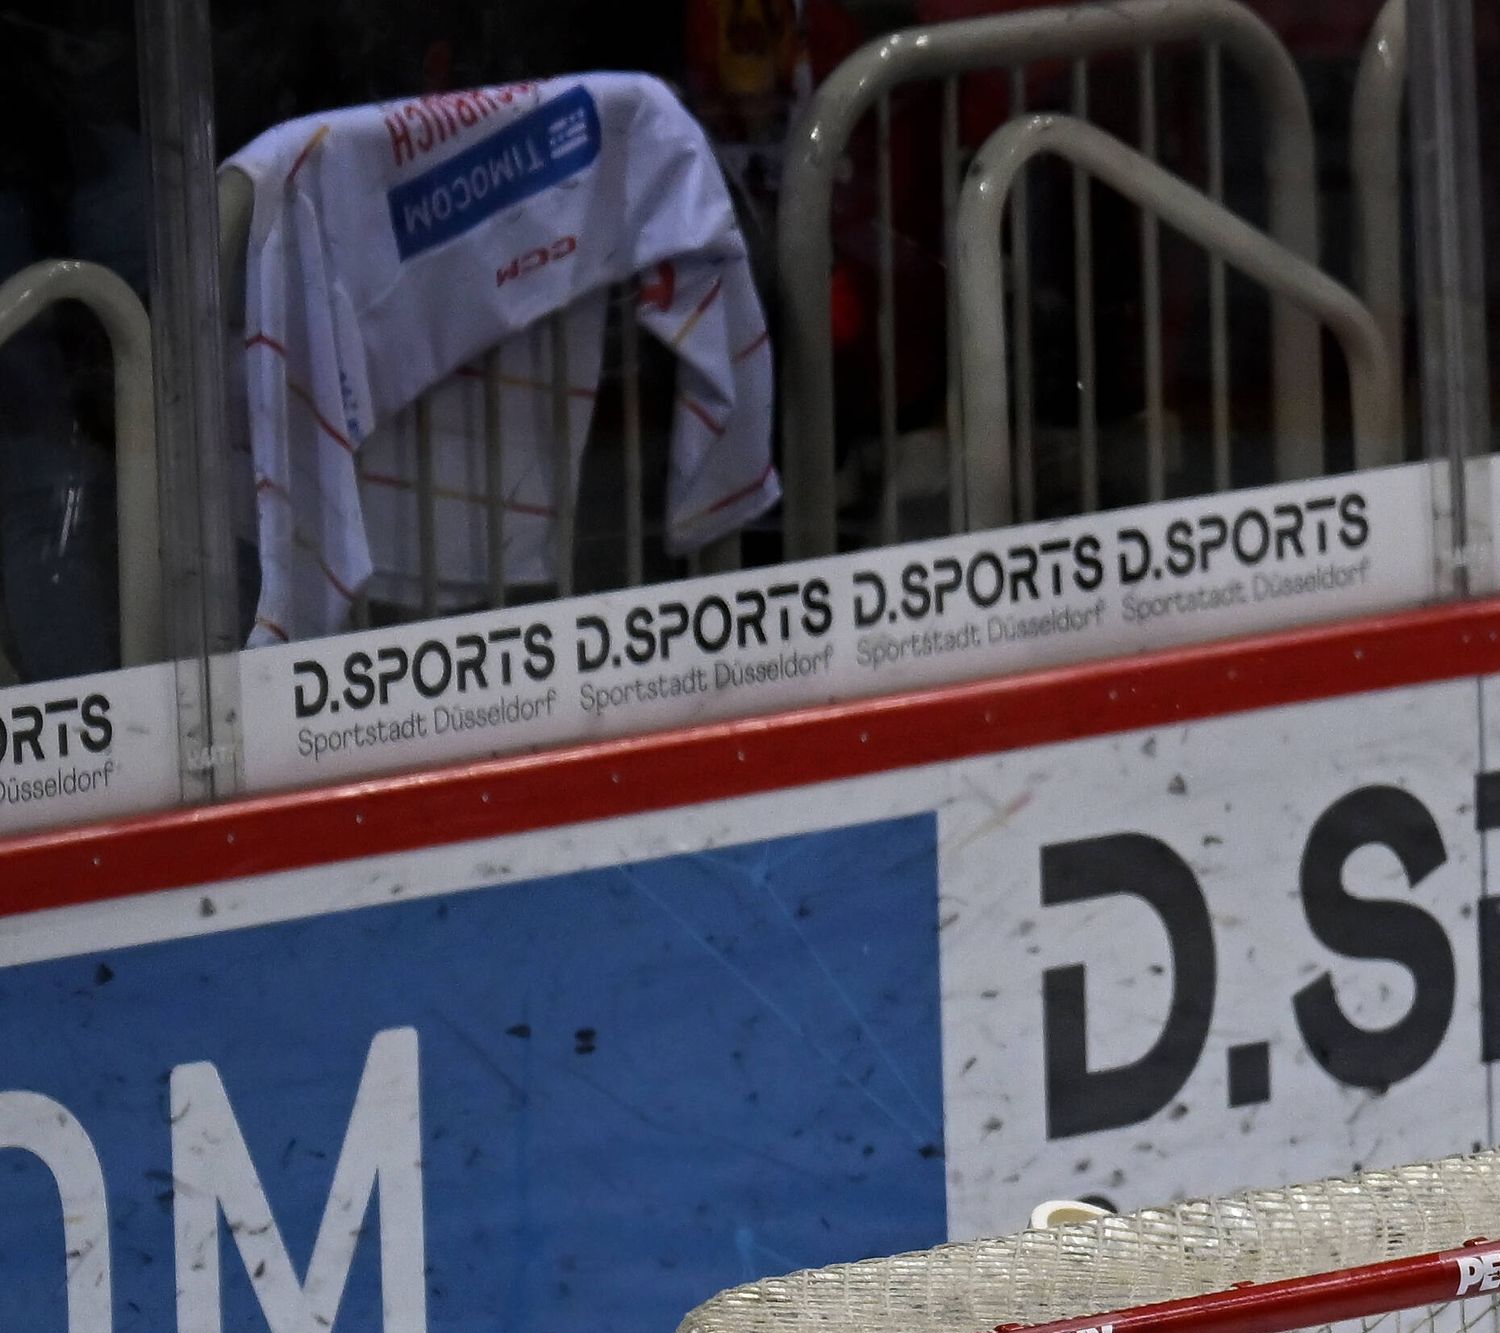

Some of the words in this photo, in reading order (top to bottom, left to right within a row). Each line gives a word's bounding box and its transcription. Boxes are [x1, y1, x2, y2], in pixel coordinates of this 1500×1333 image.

[496, 236, 577, 287] CCM
[294, 622, 556, 719] D.SPORTS
[577, 579, 833, 674] D.SPORTS
[855, 534, 1104, 630] D.SPORTS
[1120, 494, 1368, 585] D.SPORTS
[1123, 576, 1247, 625] Sportstadt
[856, 624, 981, 670] Sportstadt
[580, 667, 707, 716] Sportstadt
[0, 694, 112, 765] RTS
[299, 712, 427, 761] Sportstadt
